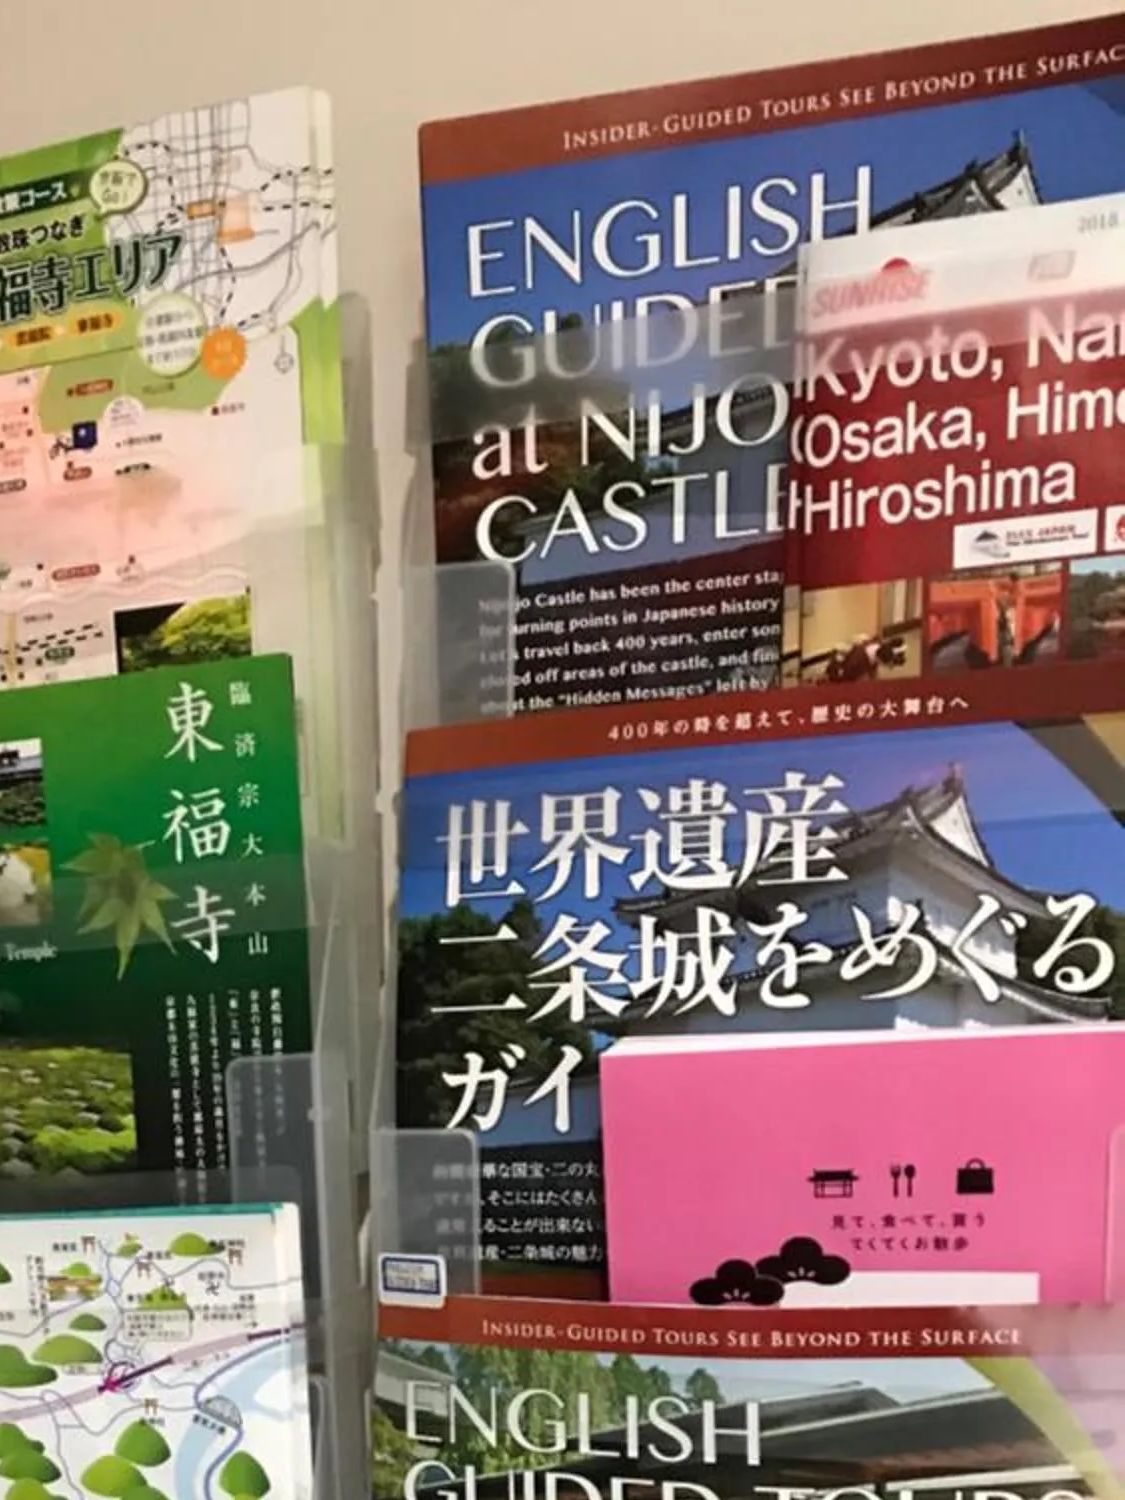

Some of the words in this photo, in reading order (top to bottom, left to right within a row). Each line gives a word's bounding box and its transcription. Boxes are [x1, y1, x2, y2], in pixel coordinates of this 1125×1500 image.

[466, 165, 873, 299] ENGLISH
[805, 324, 1004, 403] Kyoto,
[472, 402, 547, 481] at
[580, 371, 791, 467] NIJO
[804, 401, 987, 468] Osaka,
[803, 459, 1076, 535] Hiroshima
[161, 681, 237, 966] 東福寺
[437, 770, 851, 908] 世界遺産
[431, 892, 1115, 1025] 二条城をめぐる
[403, 1379, 764, 1467] ENGLISH
